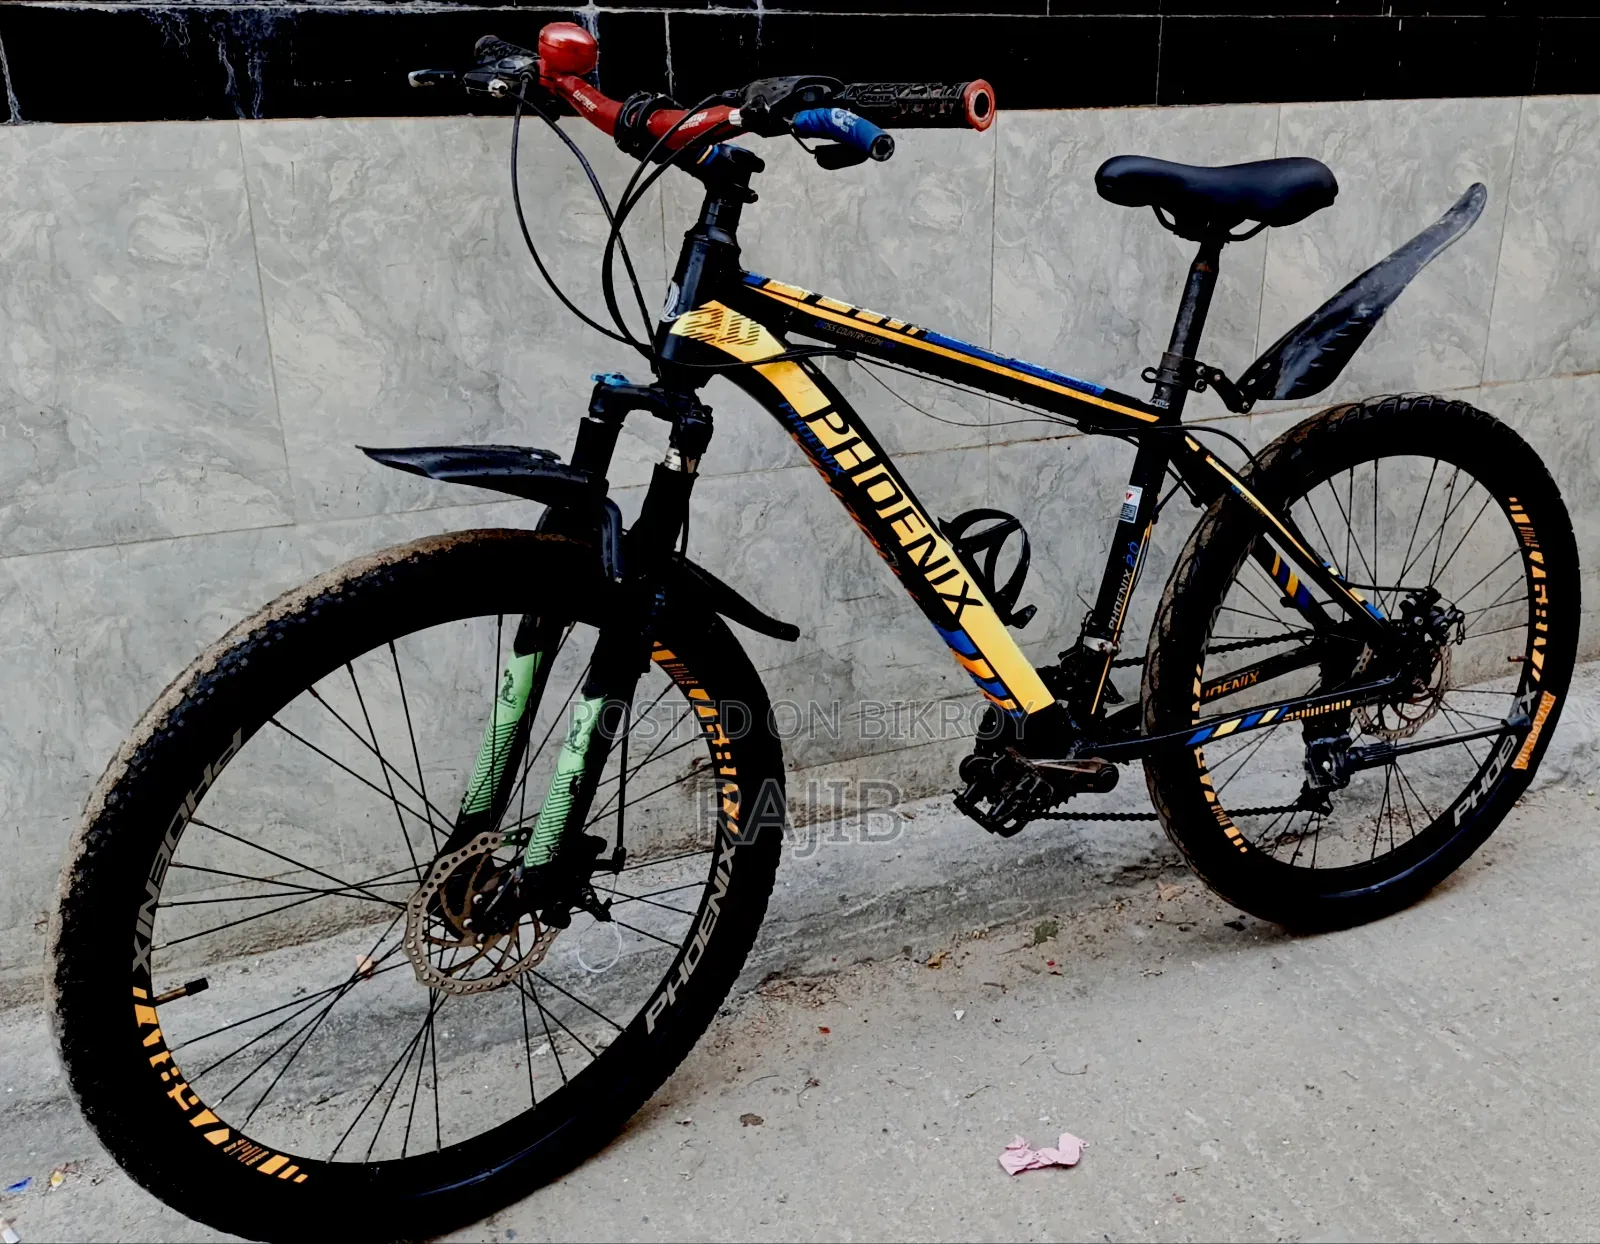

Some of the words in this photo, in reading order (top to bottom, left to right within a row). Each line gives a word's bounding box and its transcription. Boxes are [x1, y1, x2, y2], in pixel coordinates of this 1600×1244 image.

[778, 402, 847, 476] PHOENIX
[802, 404, 984, 622] PHOENIX
[1108, 568, 1132, 630] PHOENIX
[131, 728, 243, 973] PHOENIX
[646, 836, 736, 1034] PHOENIX
